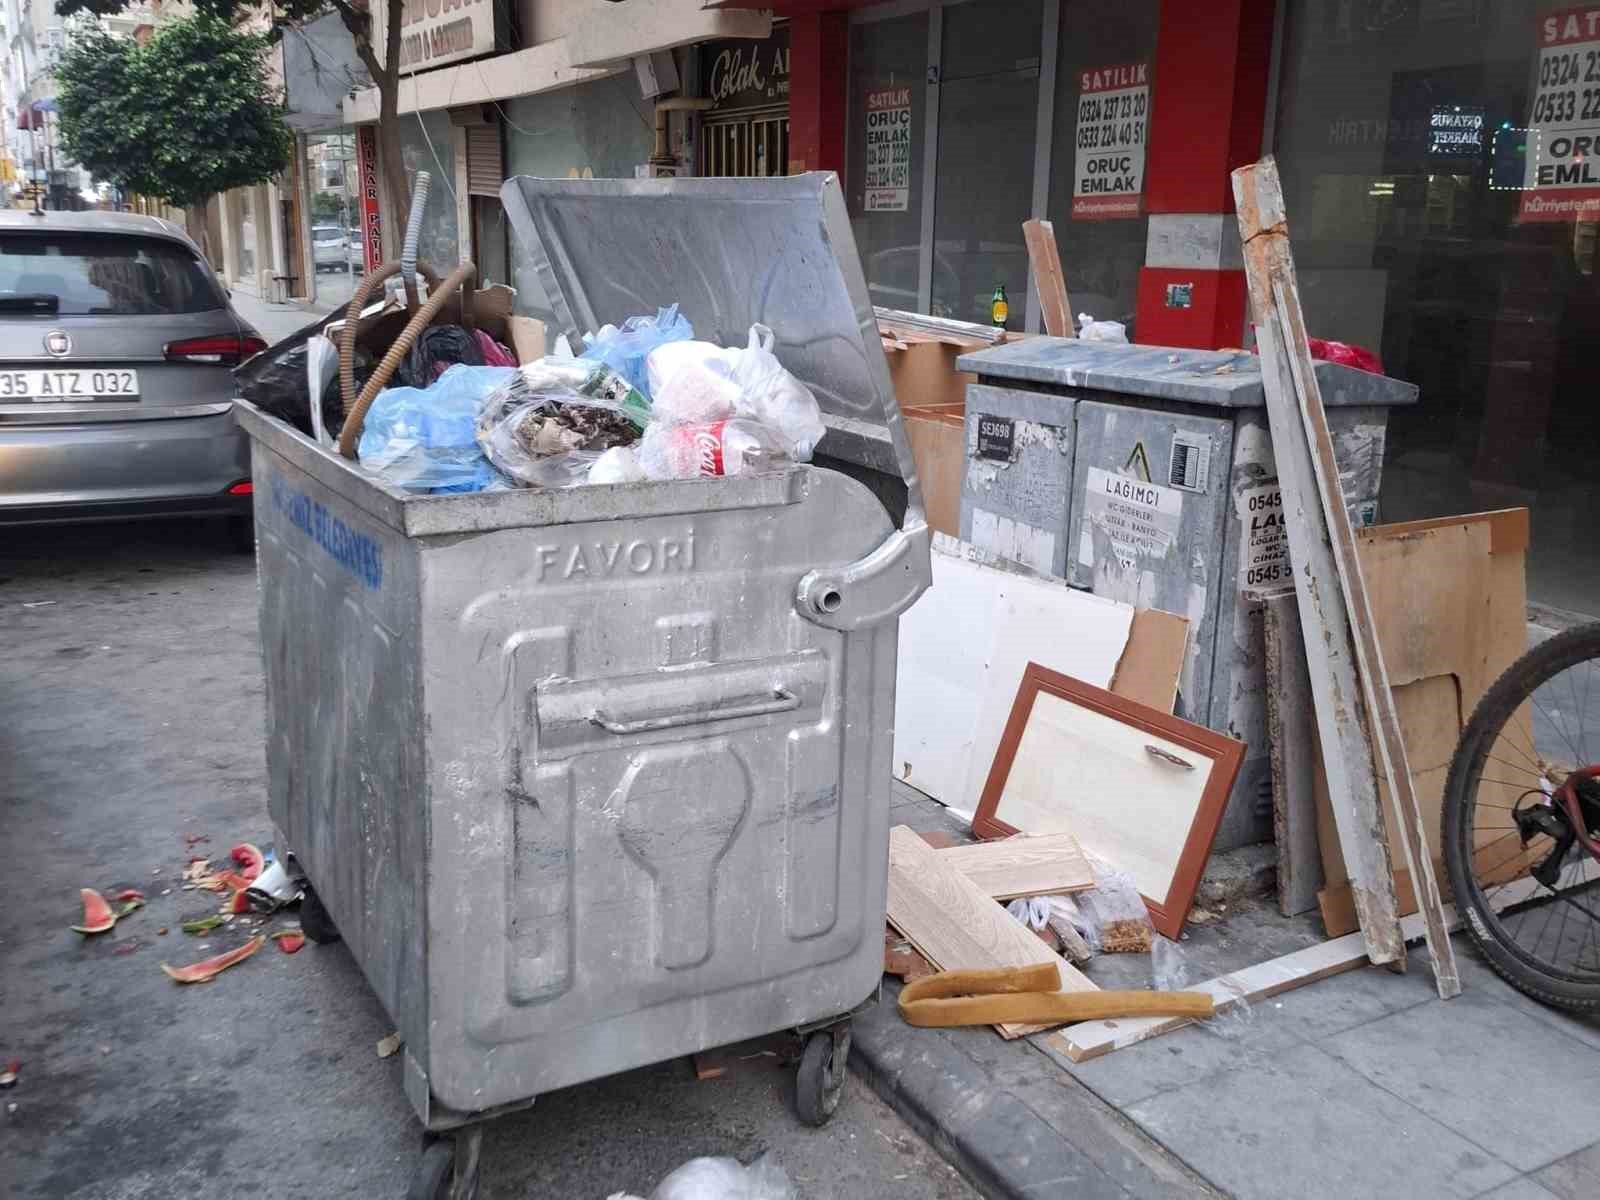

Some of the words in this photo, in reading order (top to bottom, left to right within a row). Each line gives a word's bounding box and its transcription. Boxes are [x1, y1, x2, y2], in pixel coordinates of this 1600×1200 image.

[710, 44, 766, 109] Çolak
[1081, 64, 1147, 90] SATILIK
[1541, 53, 1579, 87] 0324
[868, 89, 910, 109] SATILIK
[1080, 100, 1101, 122] 0324
[1103, 97, 1119, 120] 237
[1121, 95, 1132, 118] 23
[1134, 93, 1146, 117] 20
[1533, 90, 1576, 124] 0533
[868, 109, 910, 127] ORUÇ
[867, 128, 909, 145] EMLAK
[1078, 126, 1099, 149] 0533
[1101, 124, 1117, 147] 224
[1119, 121, 1132, 145] 40
[1134, 120, 1144, 144] 51
[1086, 157, 1132, 175] ORUÇ
[1538, 163, 1600, 185] EML
[1081, 176, 1135, 193] EMLAK
[0, 373, 28, 396] 35
[42, 372, 83, 395] ATZ
[92, 372, 133, 394] 032
[1105, 478, 1159, 507] LAĞIMCI
[1248, 492, 1282, 512] 0545
[534, 526, 696, 583] FAVORİ
[1247, 564, 1281, 585] 0545
